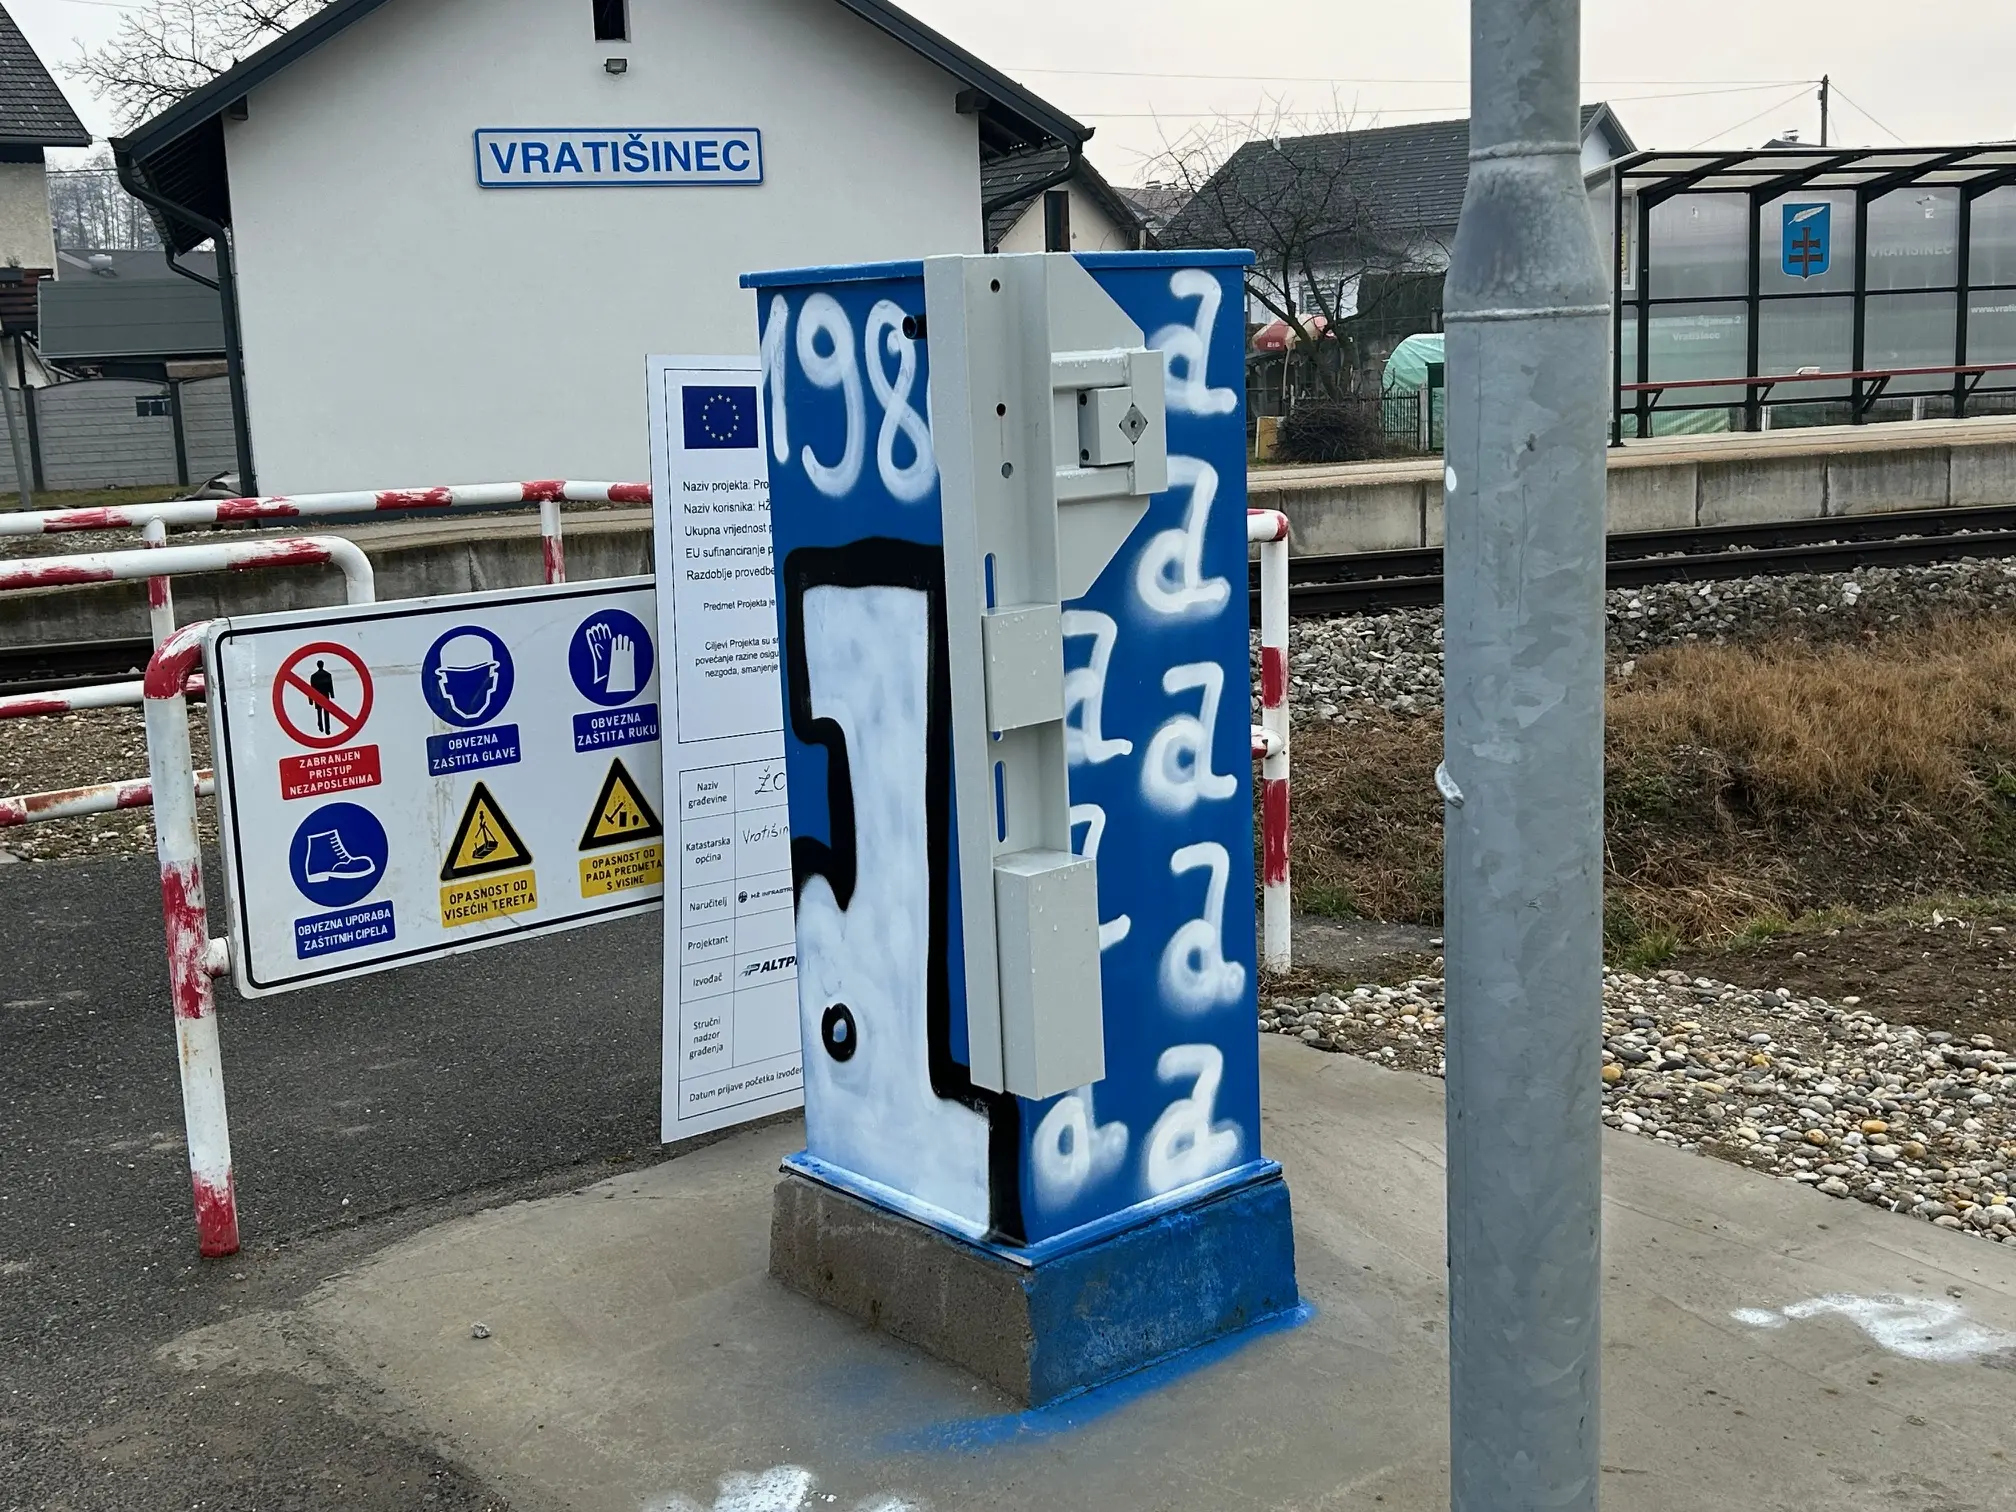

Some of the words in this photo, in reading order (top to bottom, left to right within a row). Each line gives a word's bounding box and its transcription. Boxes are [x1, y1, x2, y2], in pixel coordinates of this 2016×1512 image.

[489, 133, 751, 174] VRATIŠINEC
[1970, 304, 2016, 314] www.vrati
[760, 292, 938, 503] 198
[682, 481, 709, 492] Naziv
[712, 480, 750, 493] projekta:
[683, 503, 710, 514] Naziv
[713, 502, 755, 513] korisnika:
[685, 525, 720, 537] Ukupna
[723, 523, 766, 536] vrijednost
[686, 547, 700, 558] EU
[703, 545, 765, 558] sufinanciranje
[687, 568, 732, 580] Razdoblje
[703, 601, 735, 611] Predmet
[737, 599, 767, 610] Projekta
[705, 640, 727, 651] Ciljevi
[730, 638, 759, 649] Projekta
[695, 654, 733, 667] povećanje
[735, 651, 758, 661] razine
[705, 666, 739, 678] nezgoda,
[741, 661, 778, 675] smanjenje
[591, 712, 641, 729] OBVEZNA
[448, 733, 498, 750] OBVEZNA
[577, 729, 625, 746] ZAŠTITA
[628, 724, 657, 738] RUKU
[299, 750, 361, 769] ZABRANJEN
[433, 753, 479, 770] ZAŠTITA
[482, 746, 516, 761] GLAVE
[309, 764, 353, 779] PRISTUP
[289, 773, 374, 795] NEZAPOSLENIMA
[697, 781, 719, 791] Naziv
[688, 794, 728, 809] građevine
[685, 836, 731, 852] Katastarska
[592, 850, 640, 869] OPASNOST
[643, 848, 655, 859] OD
[695, 852, 722, 865] općina
[586, 869, 611, 883] PADA
[614, 859, 663, 876] PREDMETA
[606, 881, 613, 891] S
[615, 874, 645, 888] VISINE
[449, 882, 510, 905] OPASNOST
[513, 879, 528, 892] OD
[444, 901, 488, 921] VISEĆIH
[492, 892, 535, 910] TERETA
[689, 896, 728, 912] Naručitelj
[298, 918, 344, 936] OBVEZNA
[345, 908, 391, 927] UPORABA
[304, 931, 354, 951] ZAŠTITNIH
[355, 924, 389, 940] CIPELA
[687, 935, 729, 950] Projektant
[693, 1016, 721, 1030] Stručni
[693, 1031, 720, 1044] nadzor
[689, 1043, 724, 1060] građenja
[689, 1090, 716, 1102] Datum
[717, 1082, 744, 1096] prijave
[744, 1073, 775, 1089] početka
